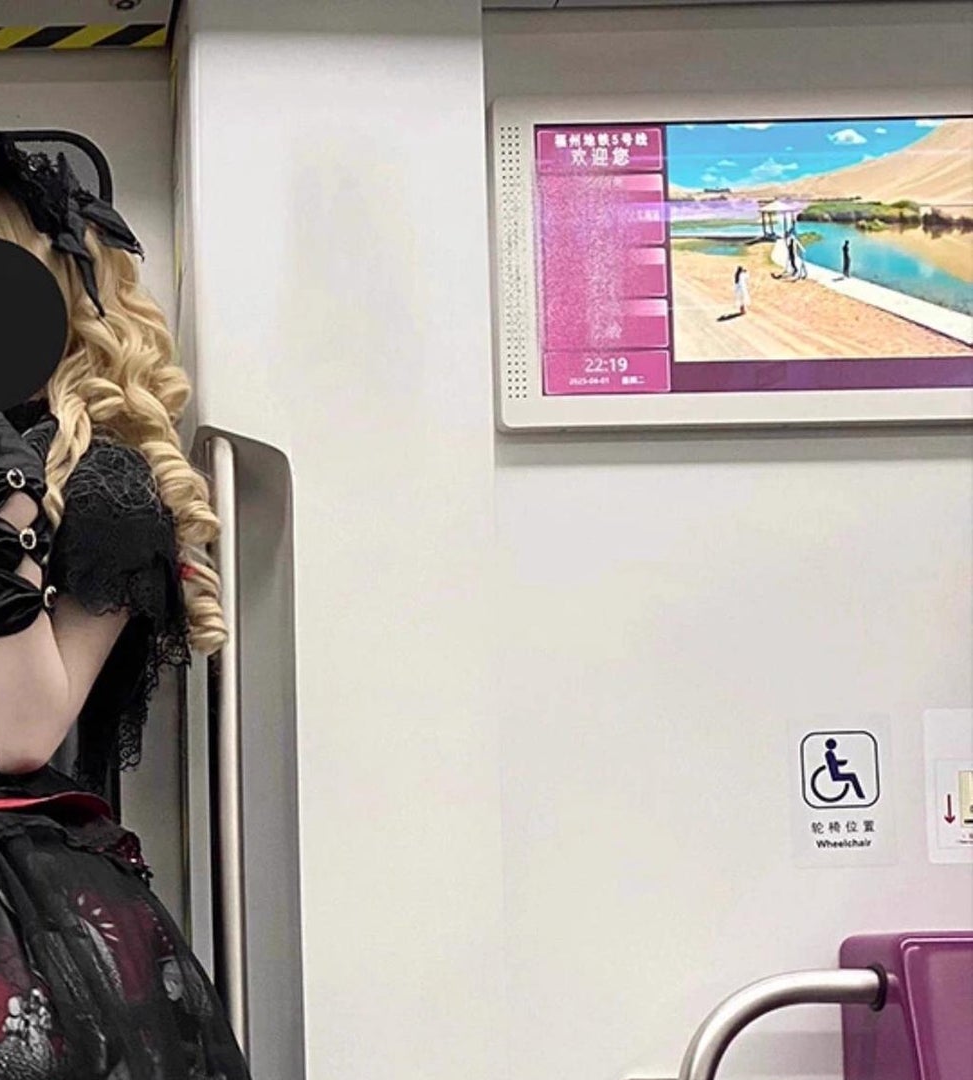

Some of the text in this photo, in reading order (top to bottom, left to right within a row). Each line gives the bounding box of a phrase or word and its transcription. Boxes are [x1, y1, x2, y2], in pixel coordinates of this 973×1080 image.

[570, 147, 630, 167] 欢迎您
[584, 356, 629, 373] 22:19
[811, 820, 875, 834] 轮椅位置
[816, 838, 872, 848] Wheelchair
